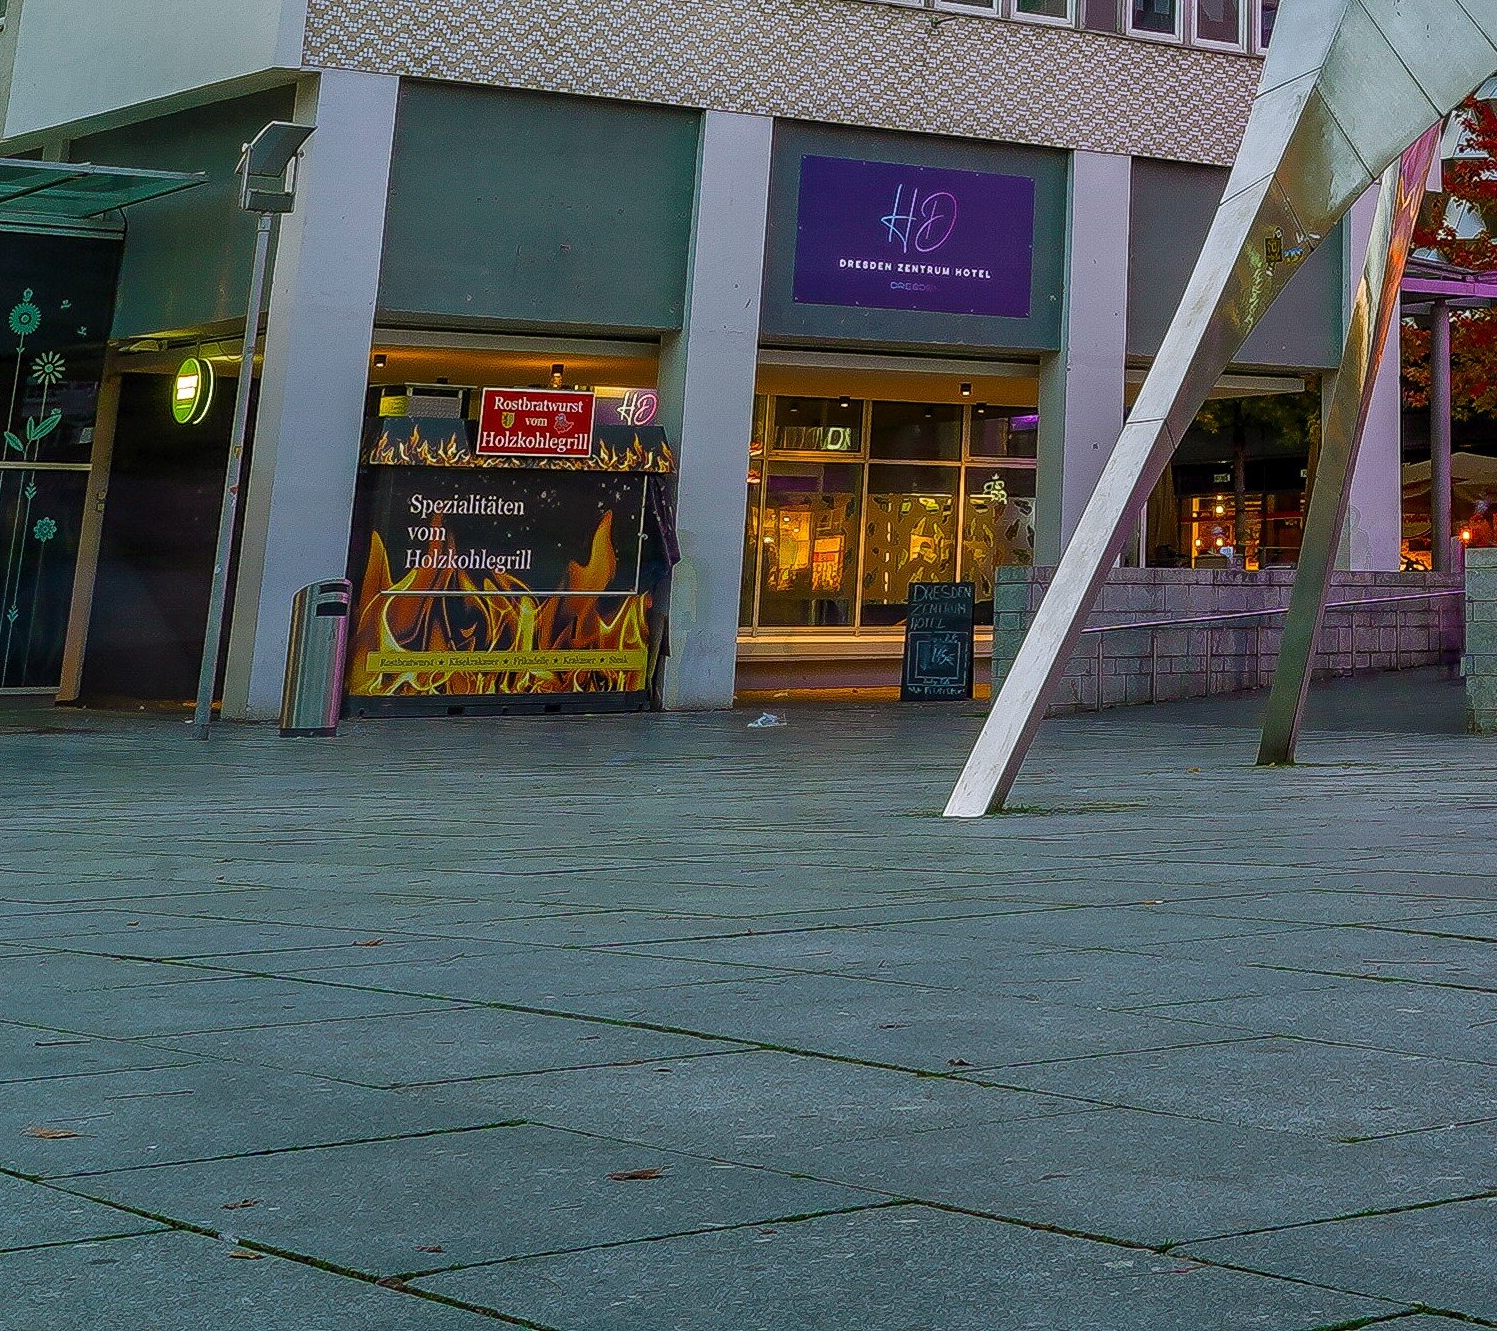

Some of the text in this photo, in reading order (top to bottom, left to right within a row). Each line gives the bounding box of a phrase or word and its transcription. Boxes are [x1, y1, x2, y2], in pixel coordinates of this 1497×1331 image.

[838, 257, 992, 280] DRESDEN ZENTRUM HOTEL
[493, 395, 584, 415] Rostbratwurst
[524, 416, 548, 427] vom
[481, 429, 590, 453] Holzkohlegrill
[409, 494, 525, 519] Spezialitäten
[407, 526, 447, 542] vom
[404, 548, 533, 575] Holzkohlegrill
